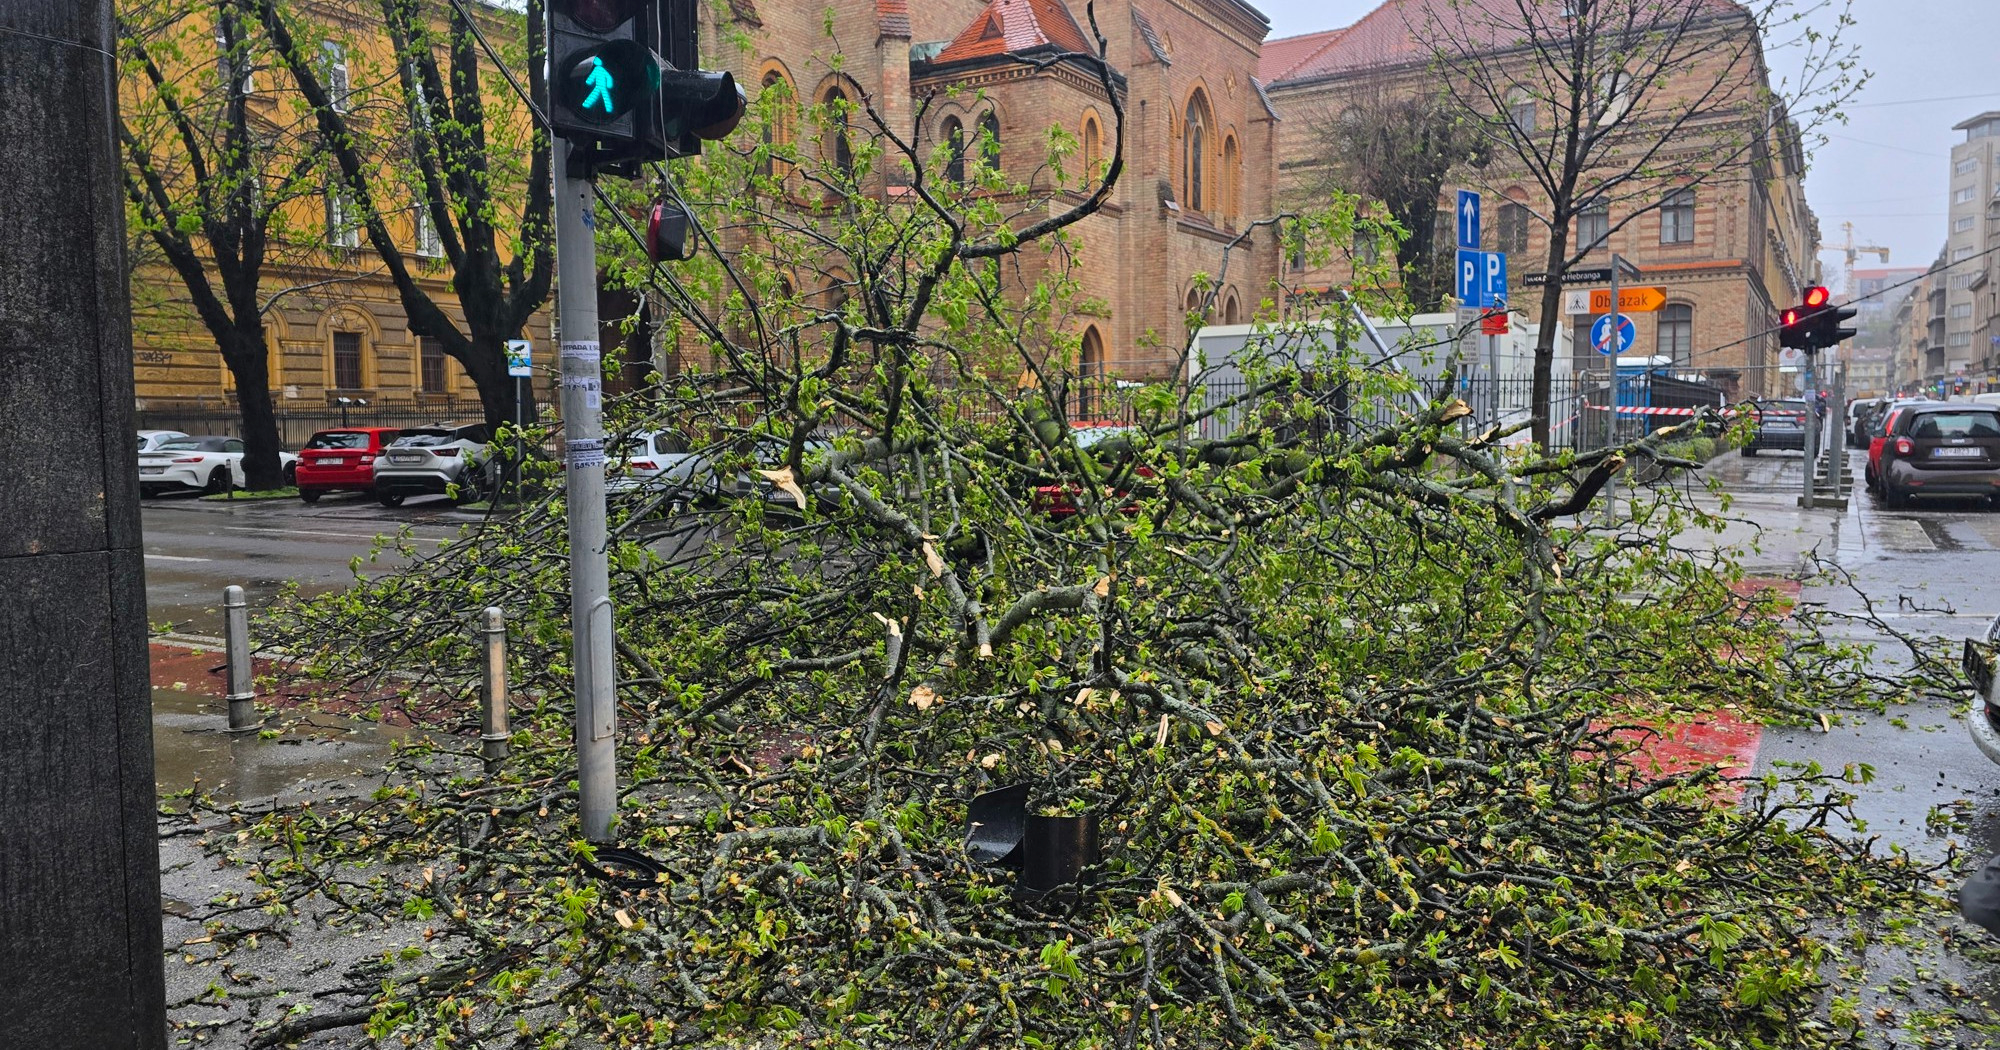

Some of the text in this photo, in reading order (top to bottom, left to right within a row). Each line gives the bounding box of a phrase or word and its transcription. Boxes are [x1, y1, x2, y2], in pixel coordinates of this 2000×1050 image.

[1464, 260, 1474, 296] P
[1486, 253, 1500, 292] P
[1595, 293, 1648, 308] Obazak
